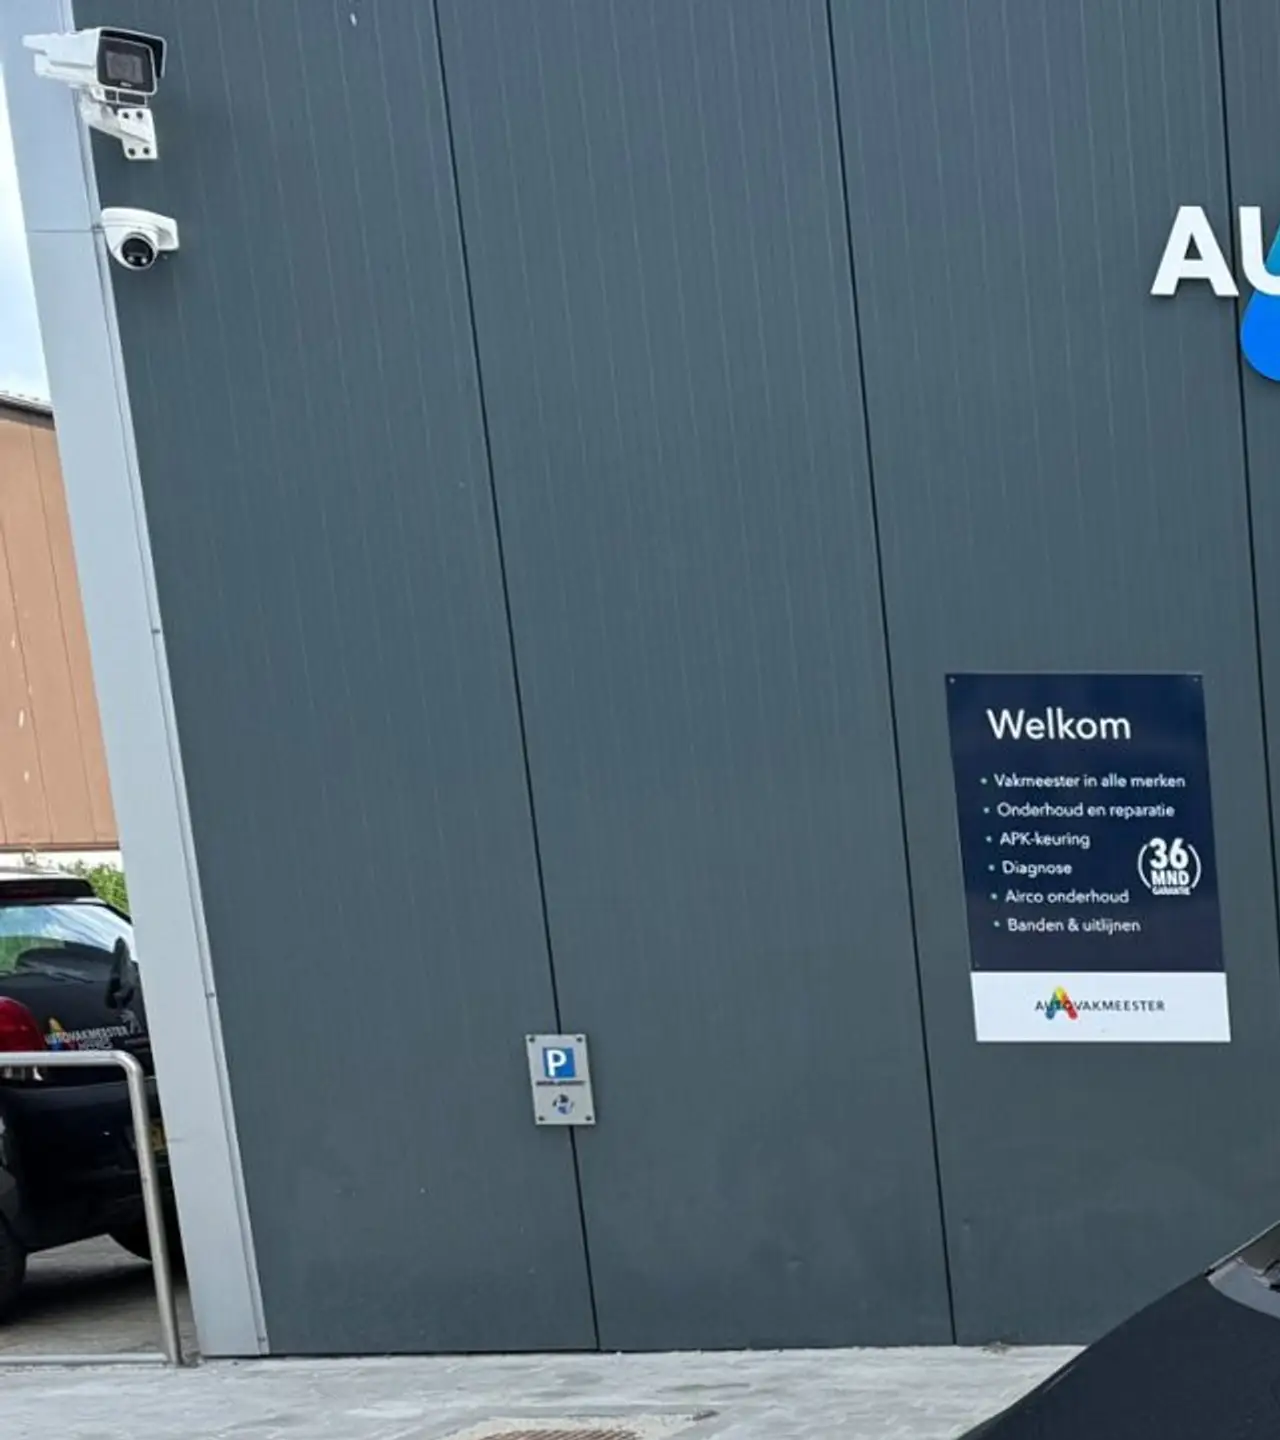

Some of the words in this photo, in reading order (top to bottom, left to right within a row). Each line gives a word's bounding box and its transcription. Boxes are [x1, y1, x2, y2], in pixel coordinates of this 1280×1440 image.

[986, 706, 1131, 740] Welkom
[994, 772, 1080, 788] Vakmeester
[1084, 773, 1097, 787] in
[1101, 772, 1128, 788] alle
[1131, 773, 1186, 788] merken
[997, 802, 1083, 817] Onderhoud
[1087, 806, 1106, 817] en
[1110, 802, 1175, 820] reparatie
[1000, 831, 1090, 849] APK-keuring
[1149, 837, 1189, 870] 36
[1002, 860, 1073, 878] Diagnose
[1151, 870, 1190, 886] MND
[1004, 889, 1043, 904] Airco
[1047, 889, 1130, 904] onderhoud
[1007, 917, 1064, 932] Banden
[1068, 918, 1079, 932] &
[1083, 917, 1141, 935] uitlijnen
[546, 1049, 567, 1077] P
